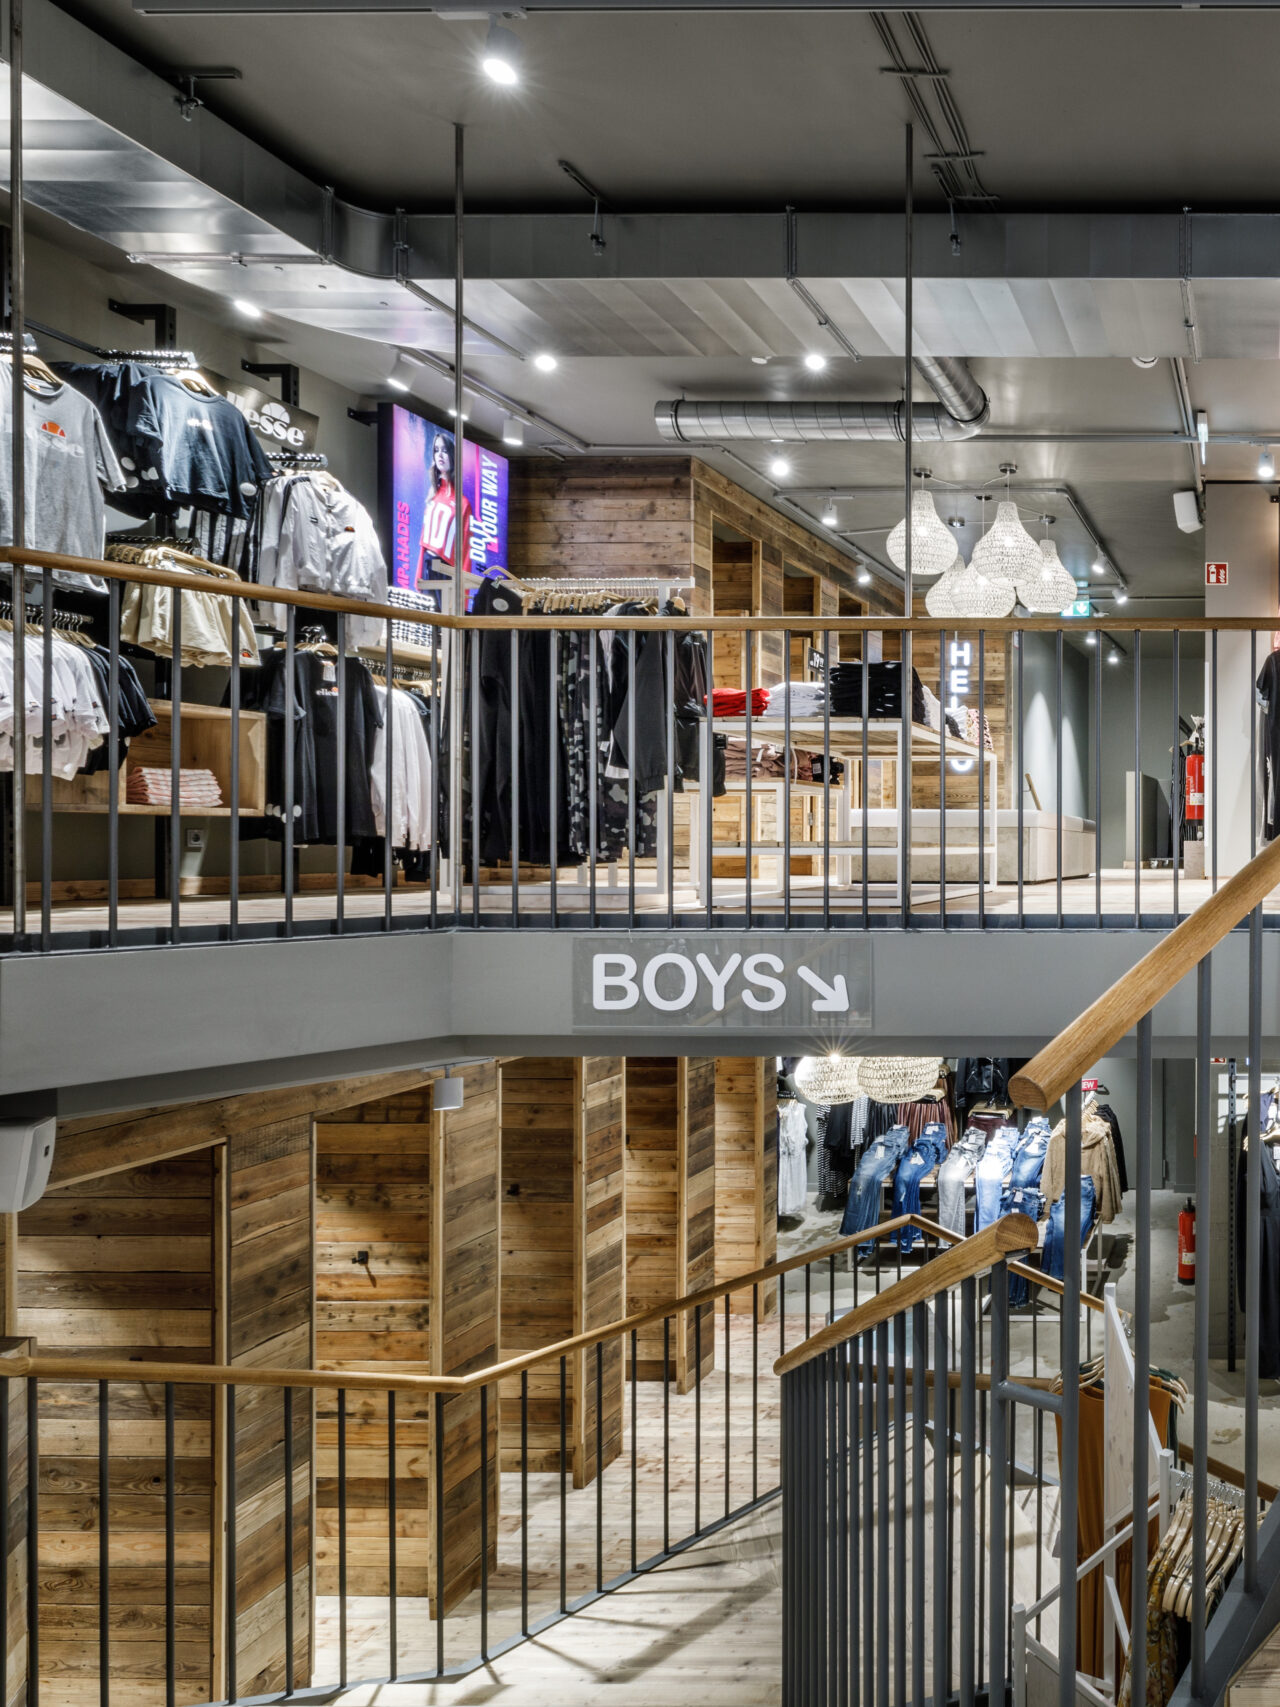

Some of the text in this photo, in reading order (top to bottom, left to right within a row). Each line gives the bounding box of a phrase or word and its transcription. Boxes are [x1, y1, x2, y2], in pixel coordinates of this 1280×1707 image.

[481, 454, 498, 544] YOUR WAY
[593, 953, 787, 1011] BOYS
